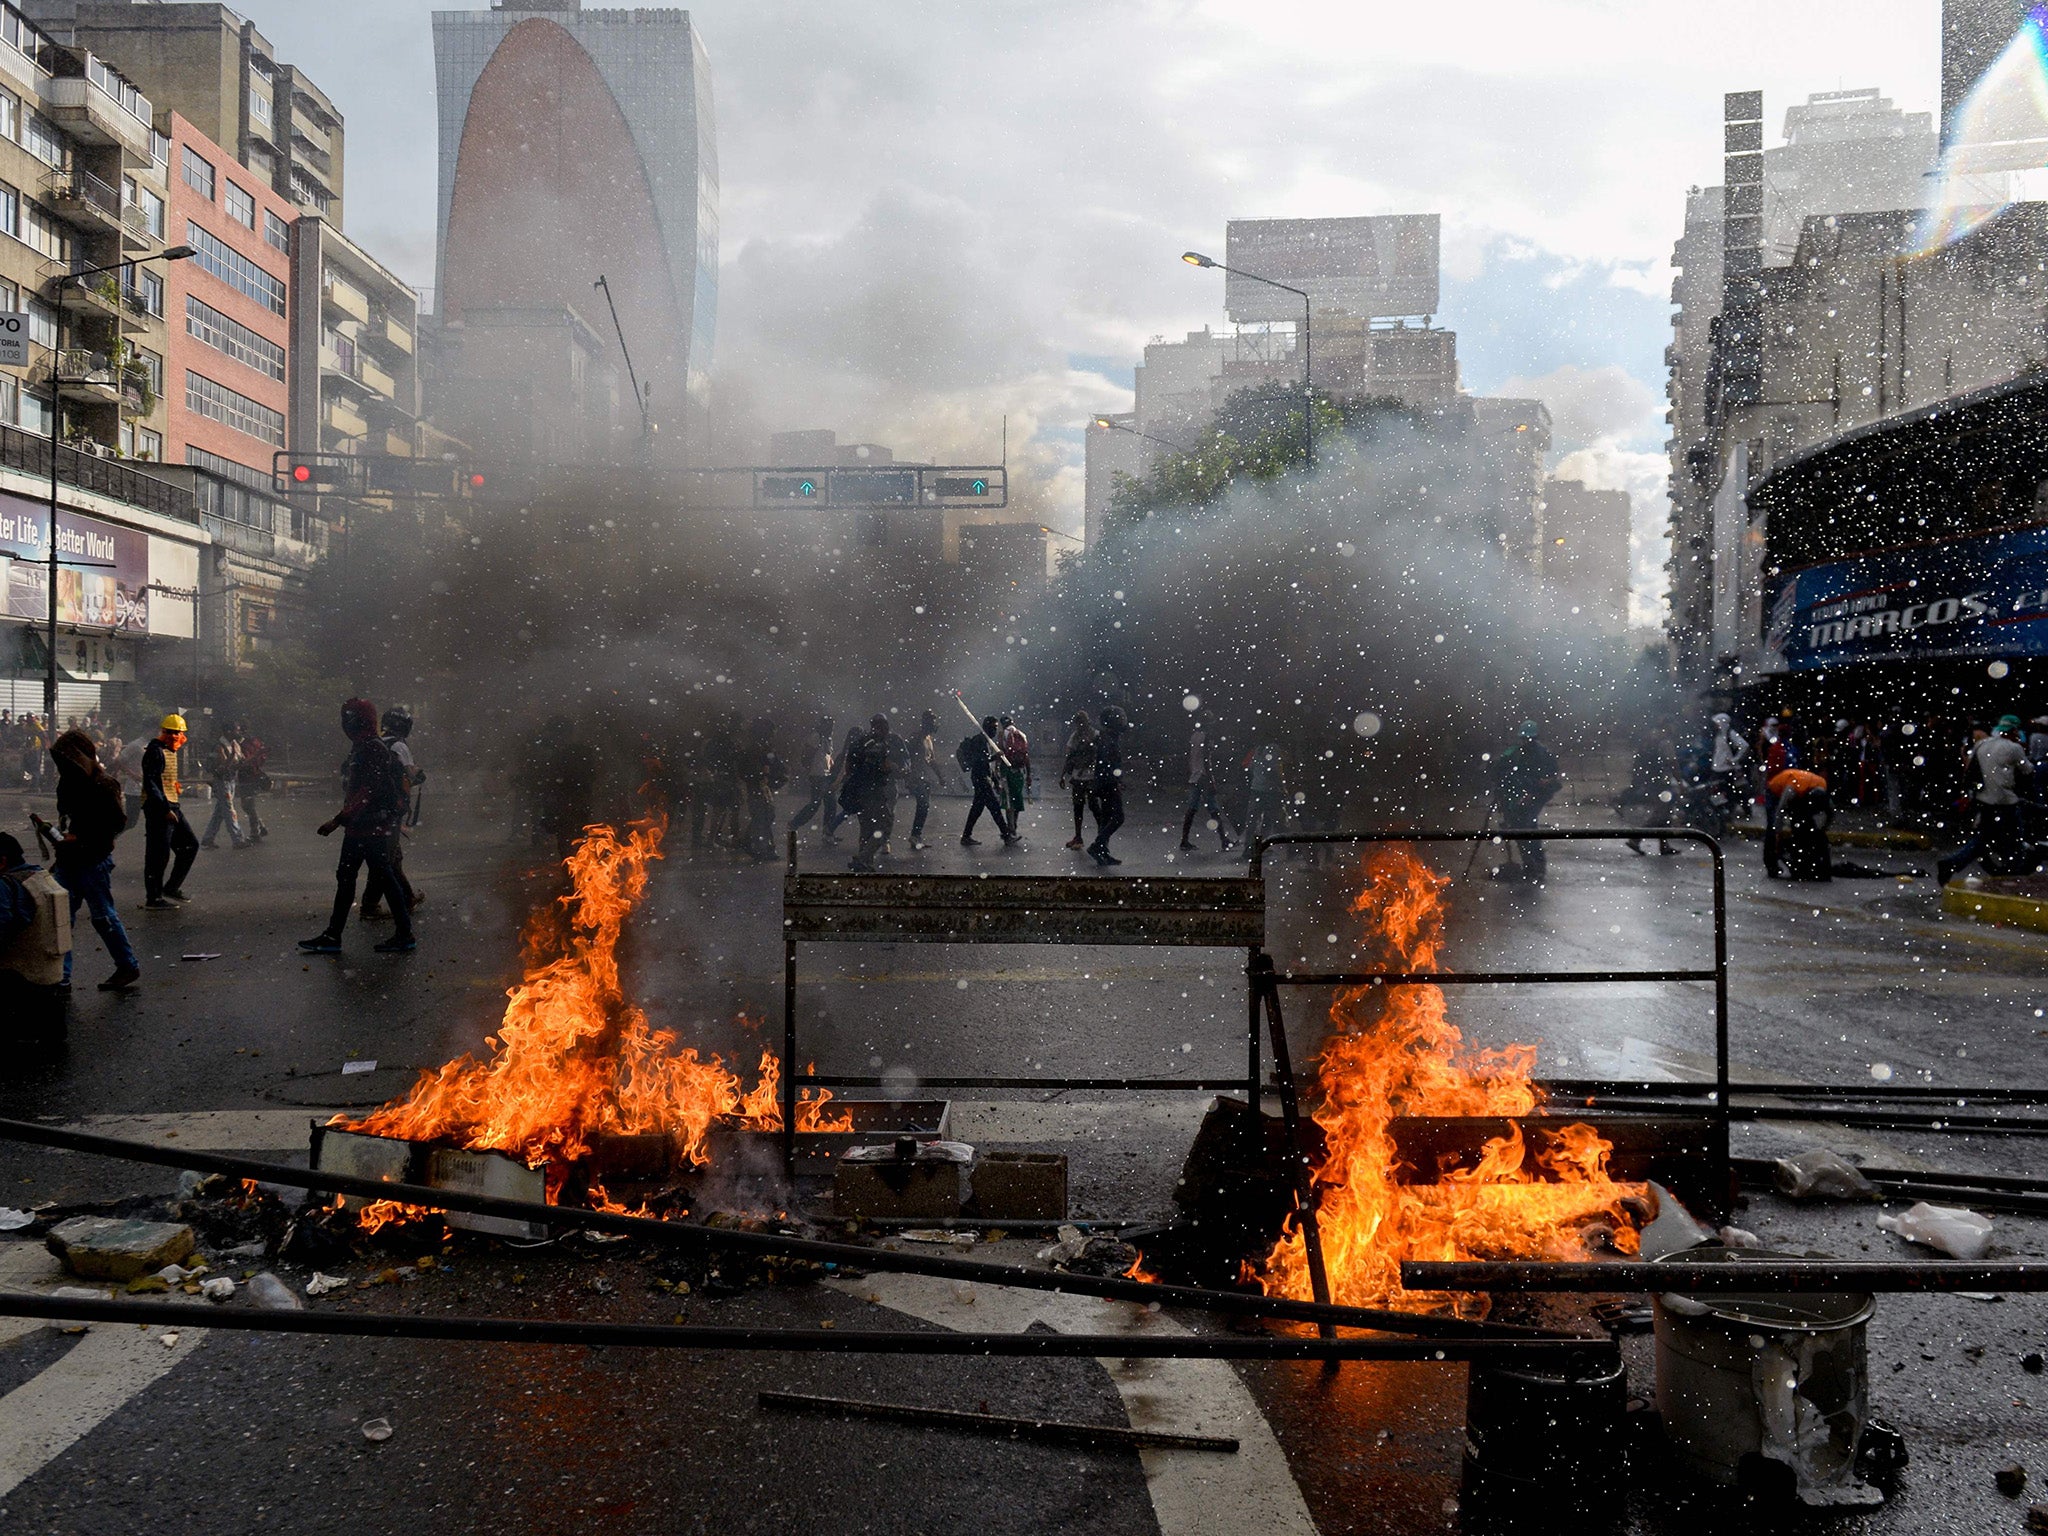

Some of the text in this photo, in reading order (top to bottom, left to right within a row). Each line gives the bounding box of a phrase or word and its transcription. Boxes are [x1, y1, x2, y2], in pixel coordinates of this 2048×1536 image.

[0, 339, 20, 348] ORIA
[17, 515, 41, 550] Life,
[54, 524, 85, 555] Better
[86, 531, 114, 561] World
